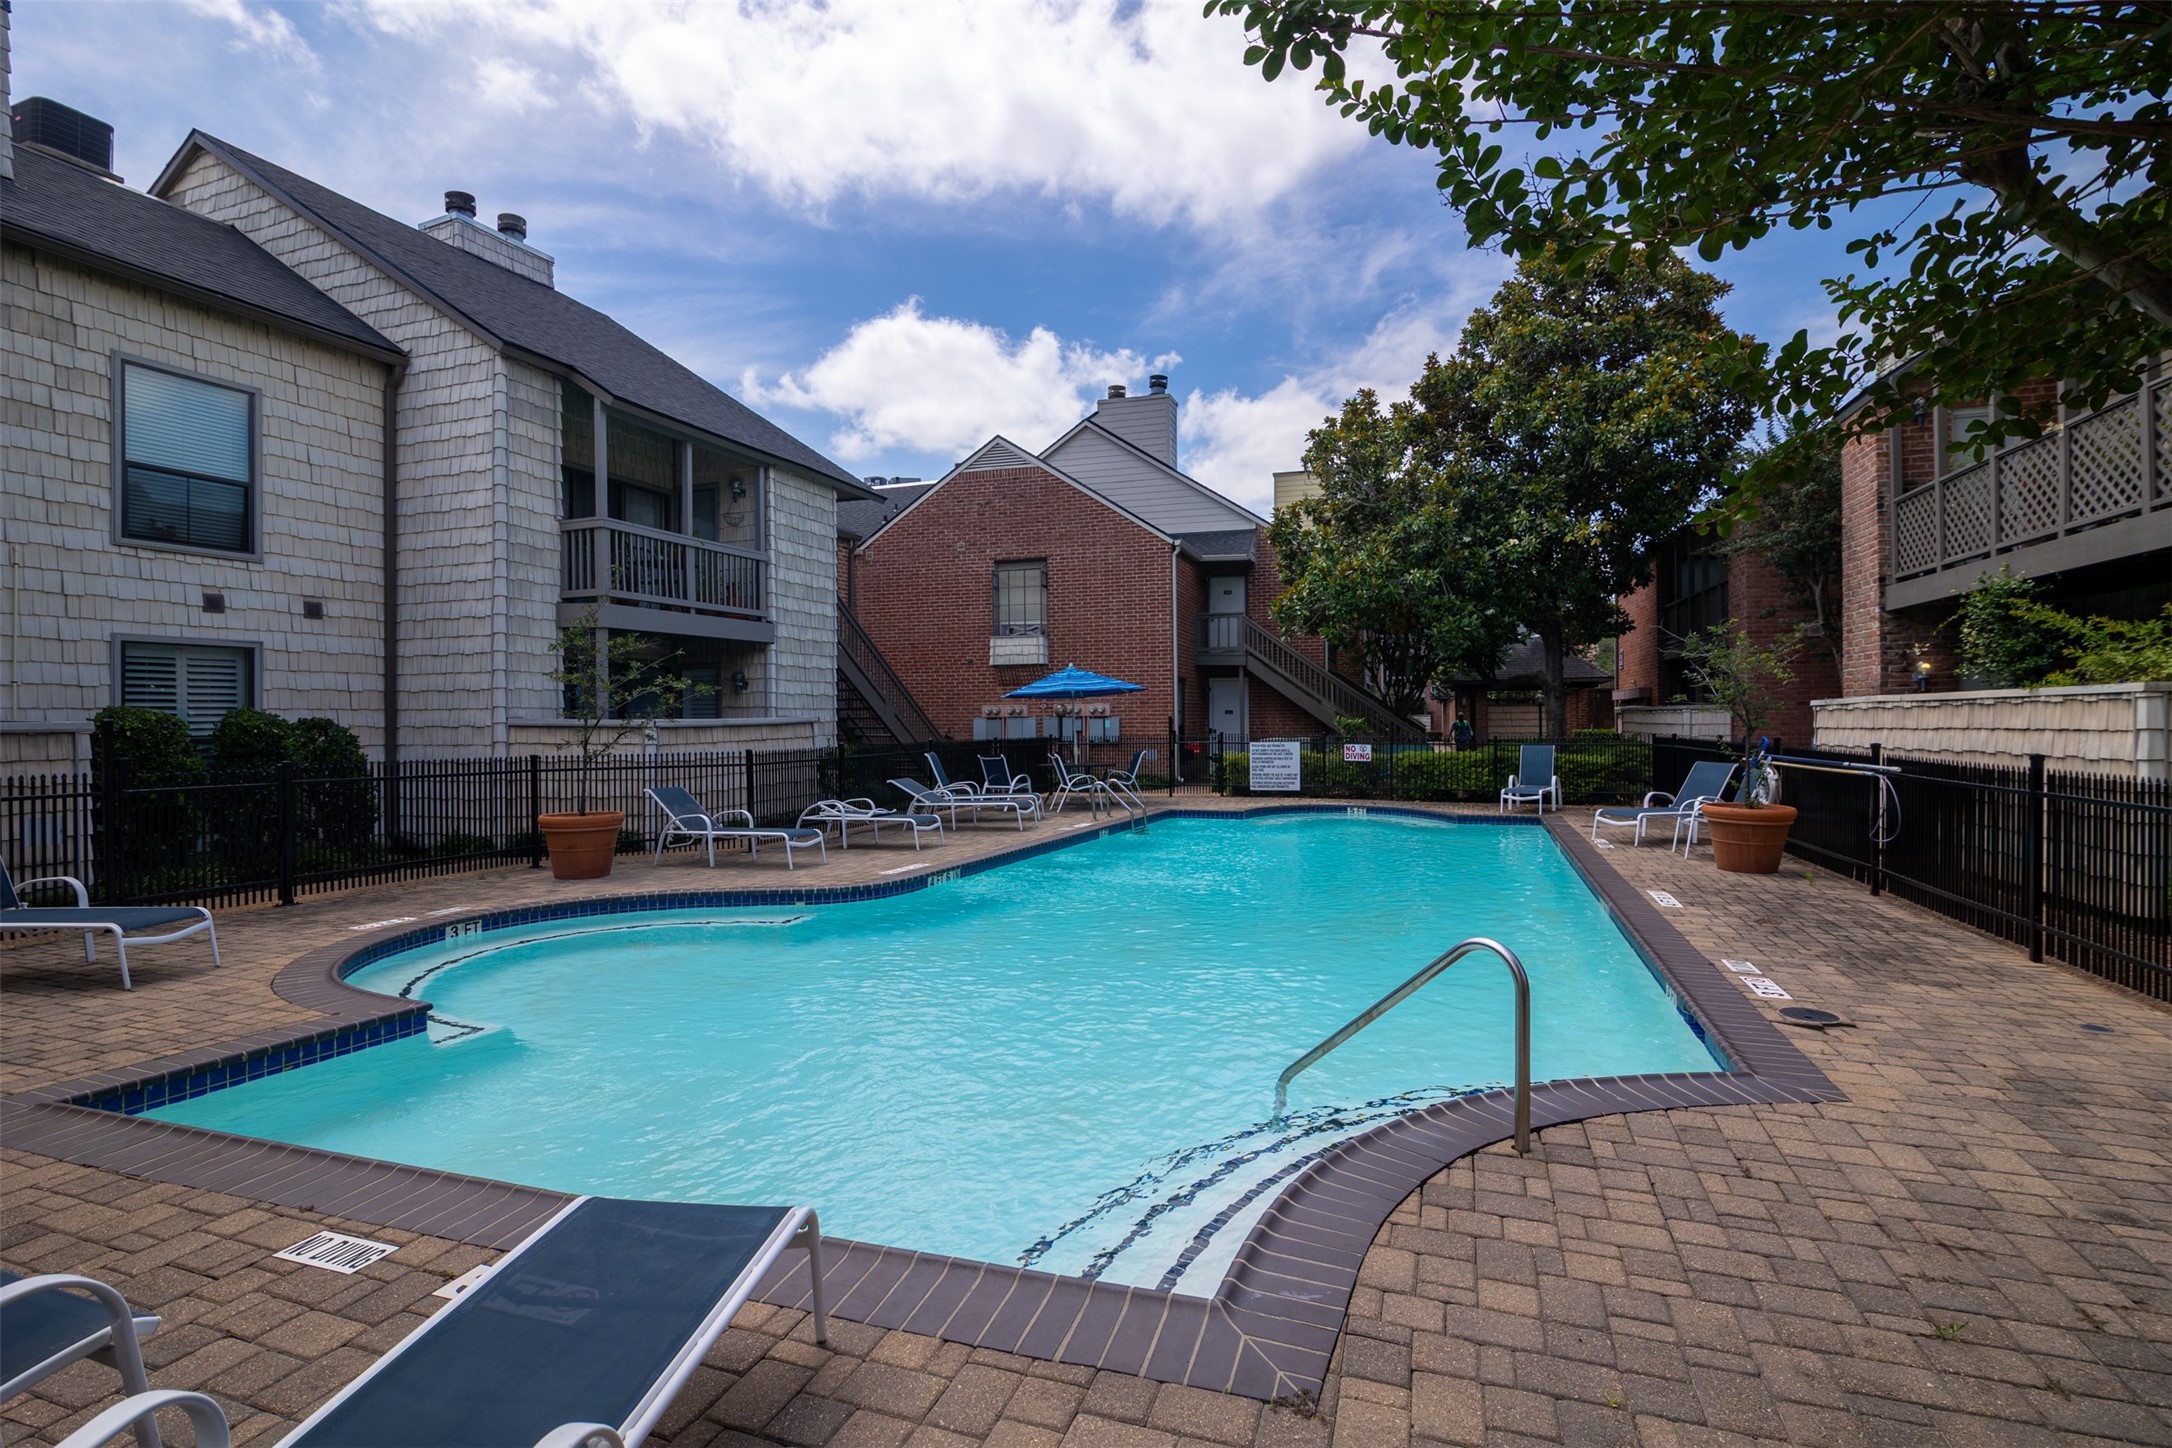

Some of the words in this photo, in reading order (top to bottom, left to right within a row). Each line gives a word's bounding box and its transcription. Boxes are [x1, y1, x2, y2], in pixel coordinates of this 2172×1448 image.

[1345, 752, 1370, 760] DIVING
[930, 876, 935, 886] 4
[945, 872, 951, 882] 6
[450, 925, 459, 939] 3
[464, 921, 480, 935] FT
[283, 1234, 334, 1256] NO
[308, 1240, 387, 1269] DIVING
